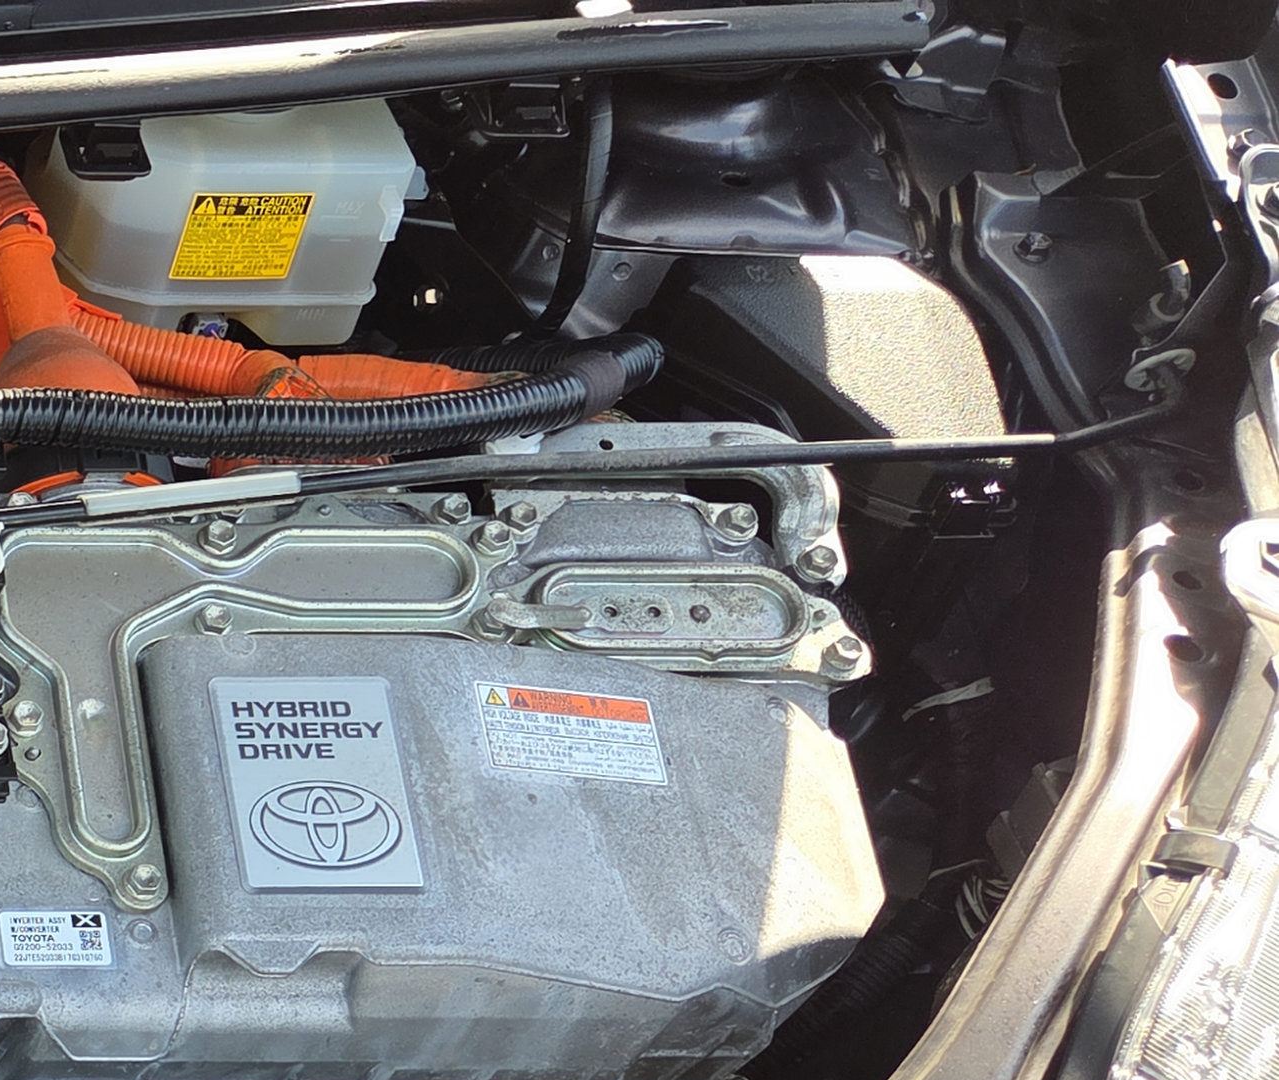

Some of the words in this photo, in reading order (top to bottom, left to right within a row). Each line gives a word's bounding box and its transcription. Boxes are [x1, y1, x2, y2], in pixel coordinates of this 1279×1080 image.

[260, 196, 308, 206] CAUTION
[244, 205, 303, 215] ATTENTION
[231, 701, 352, 718] HYBRID
[234, 721, 383, 739] SYNERGY
[238, 743, 335, 760] DRIVE
[11, 934, 55, 942] TOYOTA
